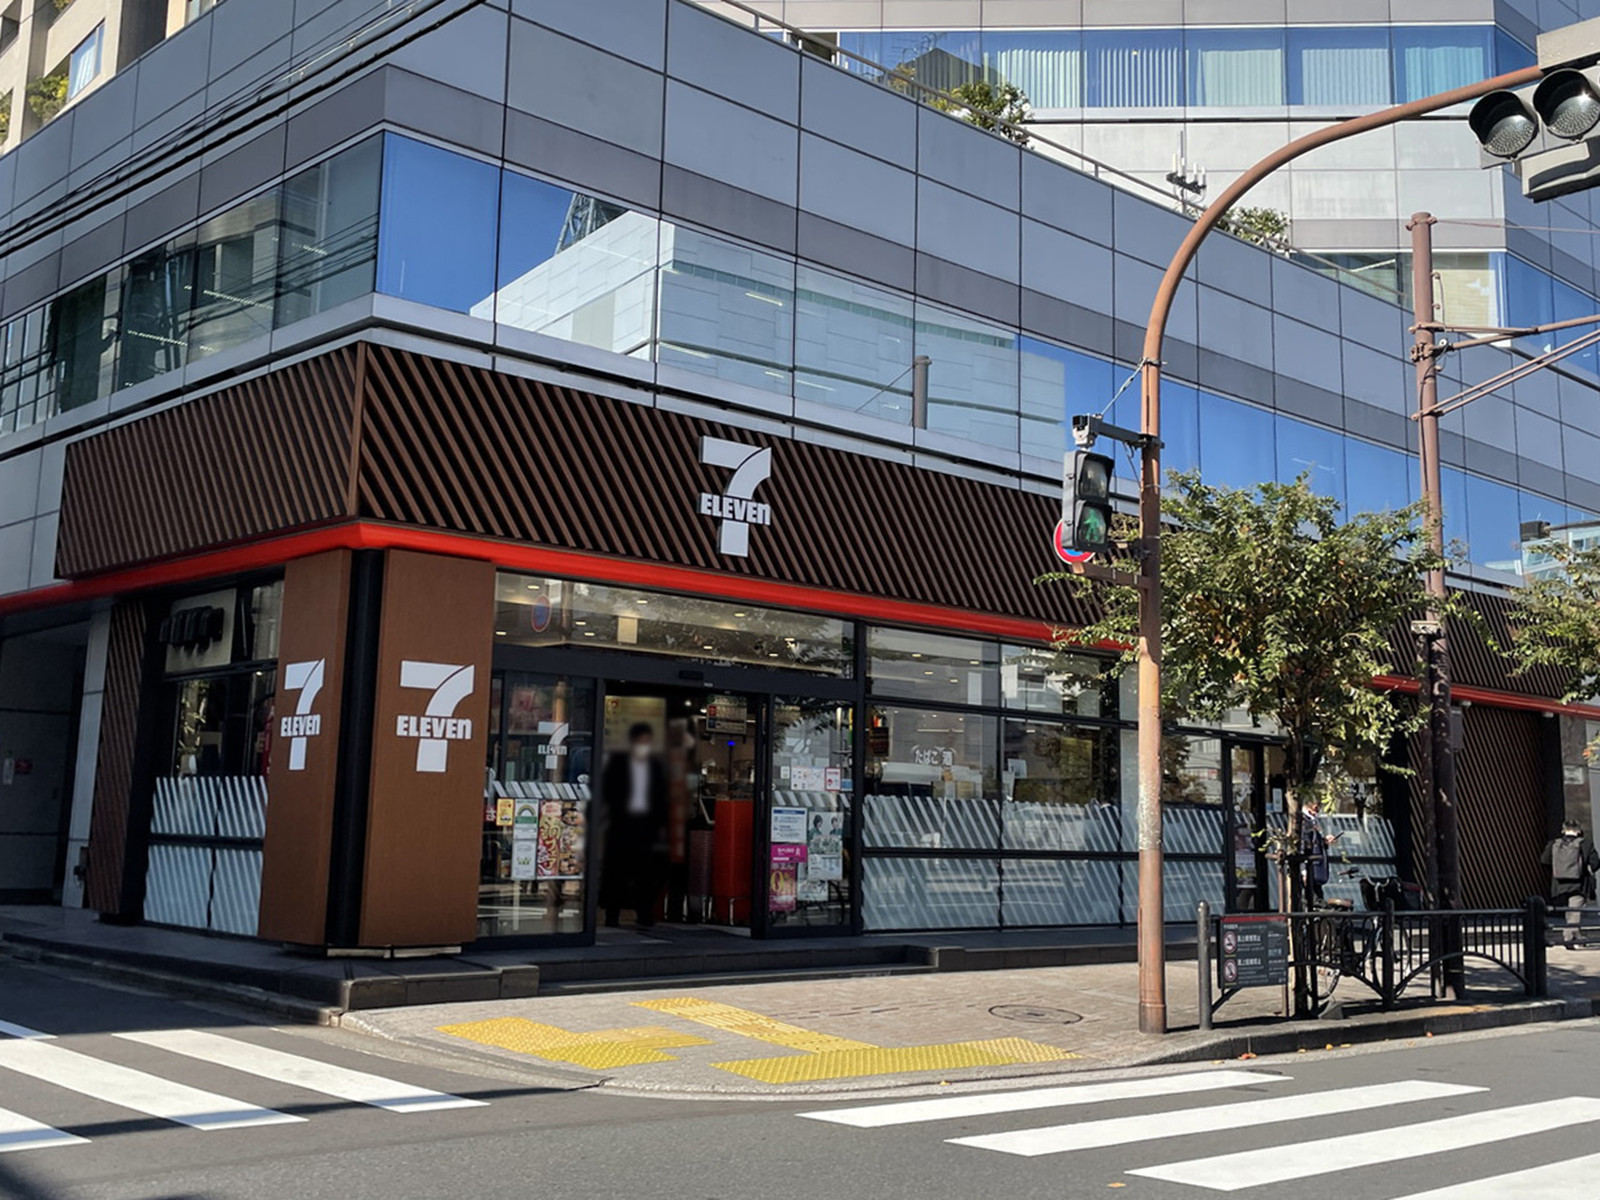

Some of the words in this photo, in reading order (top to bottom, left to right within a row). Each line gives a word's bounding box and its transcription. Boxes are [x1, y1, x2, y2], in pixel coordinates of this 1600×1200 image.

[698, 435, 772, 558] 7
[284, 657, 325, 771] 7
[399, 660, 475, 773] 7
[915, 749, 938, 766] たばこ
